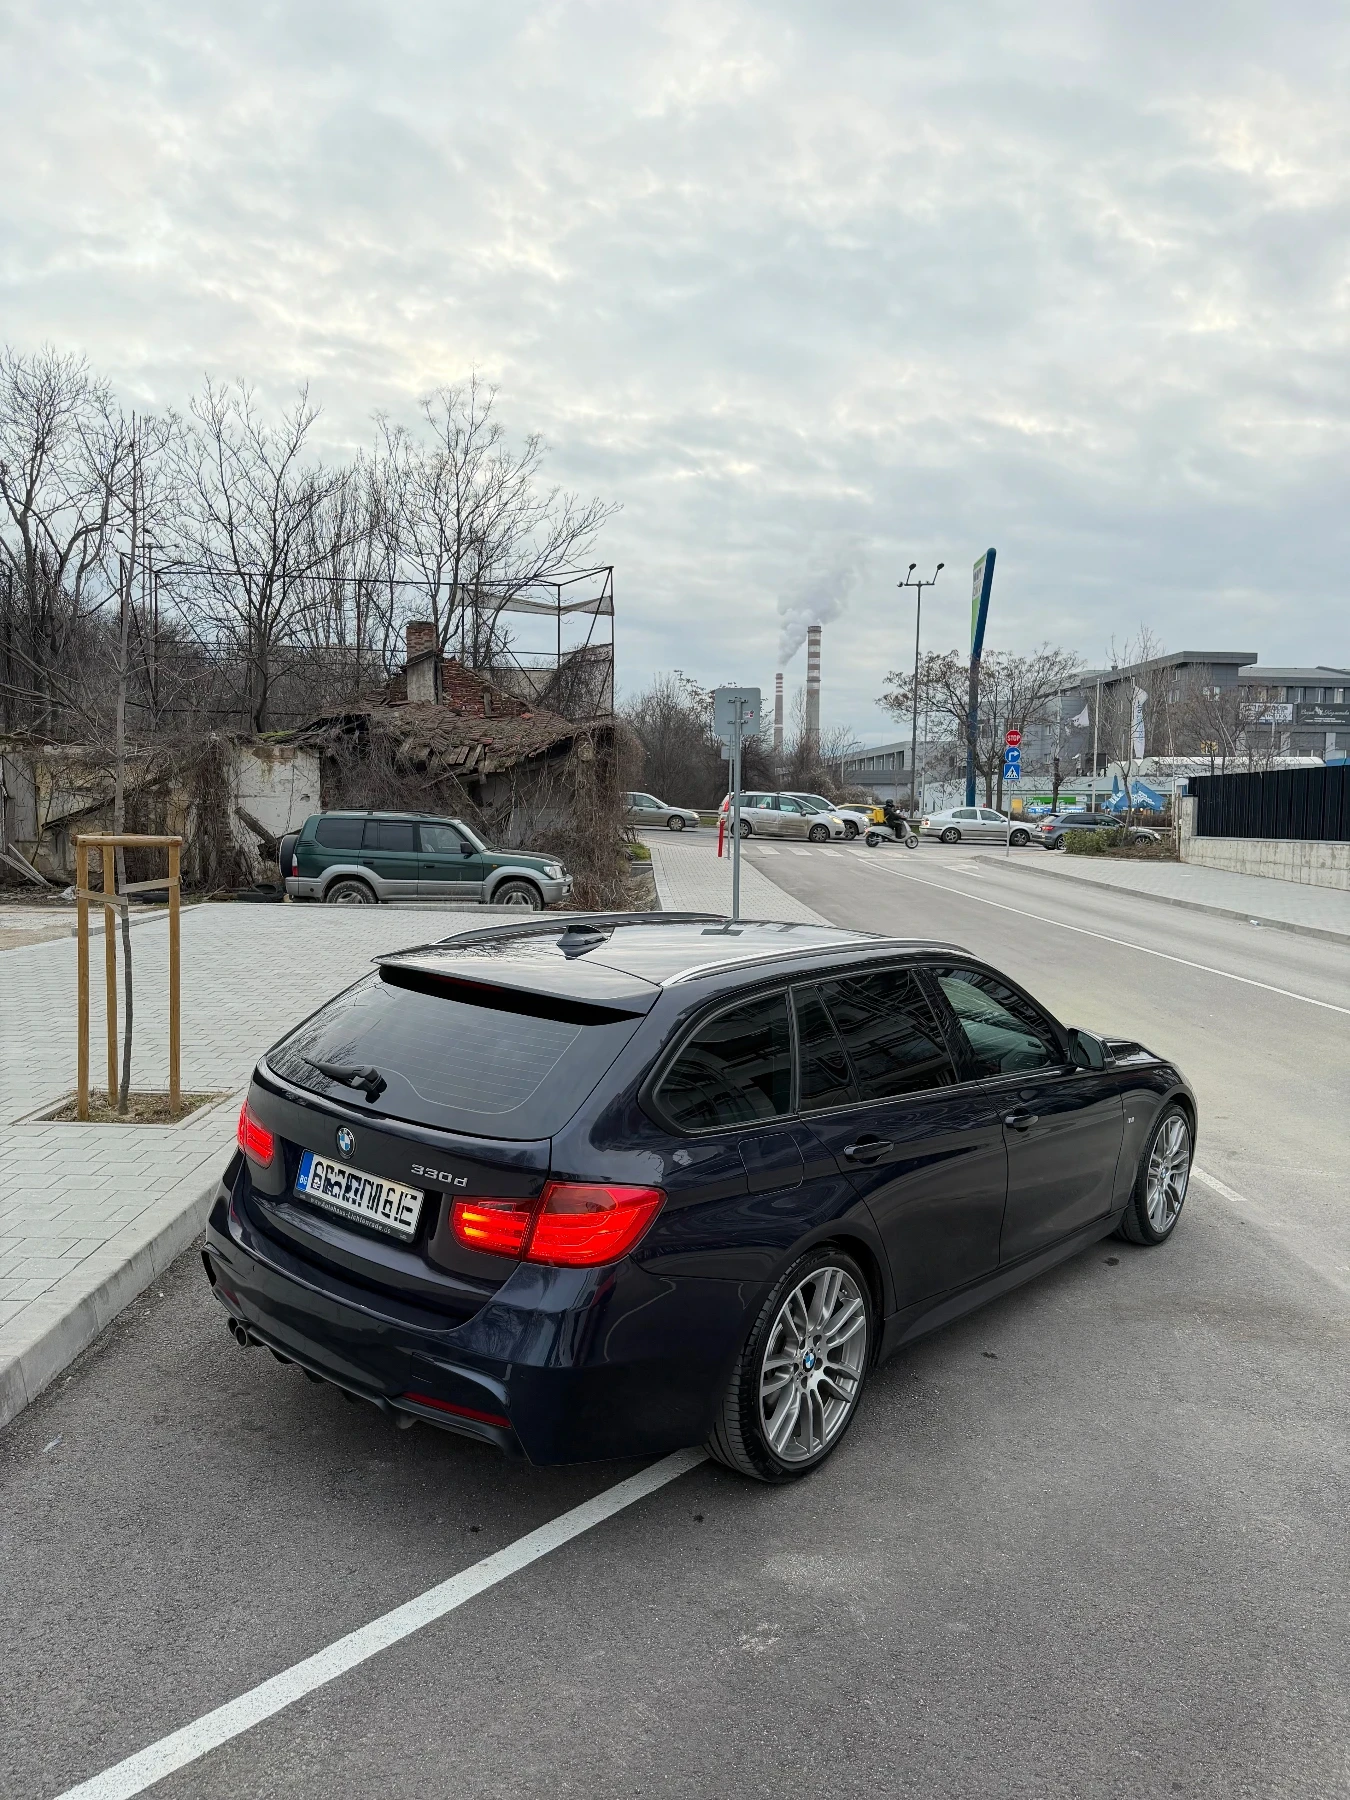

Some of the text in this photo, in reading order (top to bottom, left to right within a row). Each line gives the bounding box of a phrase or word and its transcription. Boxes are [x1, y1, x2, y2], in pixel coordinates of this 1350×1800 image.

[1007, 734, 1021, 742] STOP
[299, 1174, 308, 1185] BG
[410, 1163, 468, 1188] 330d
